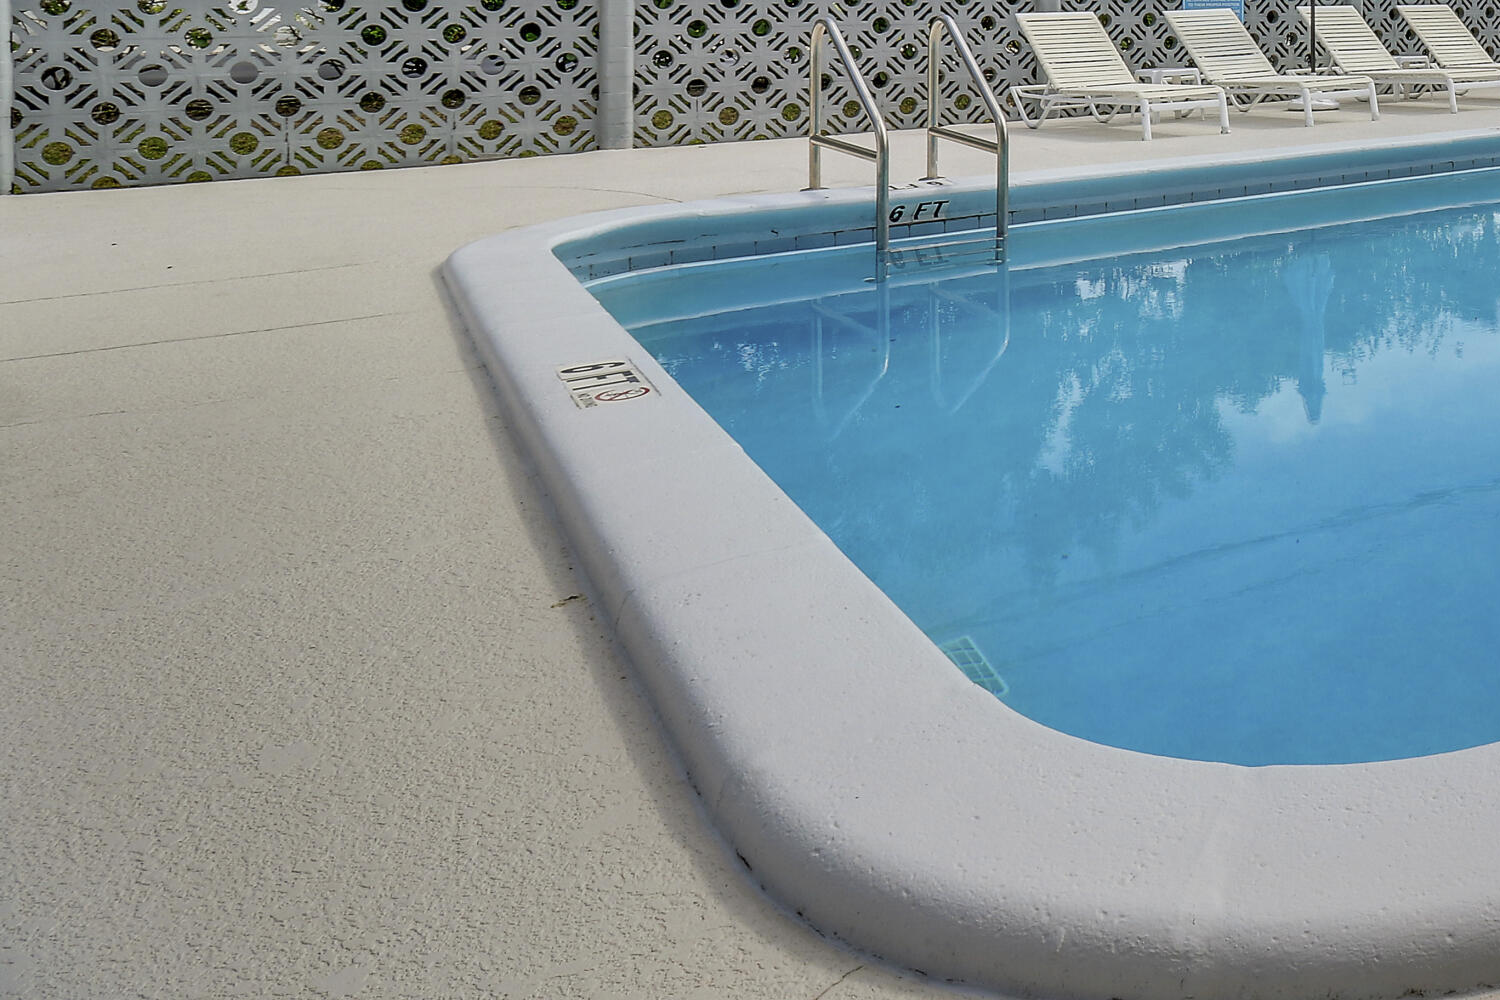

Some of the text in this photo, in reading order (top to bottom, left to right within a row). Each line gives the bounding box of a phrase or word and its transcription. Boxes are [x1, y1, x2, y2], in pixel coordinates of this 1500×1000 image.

[889, 200, 950, 223] 6 FT
[560, 361, 640, 391] 6 FT
